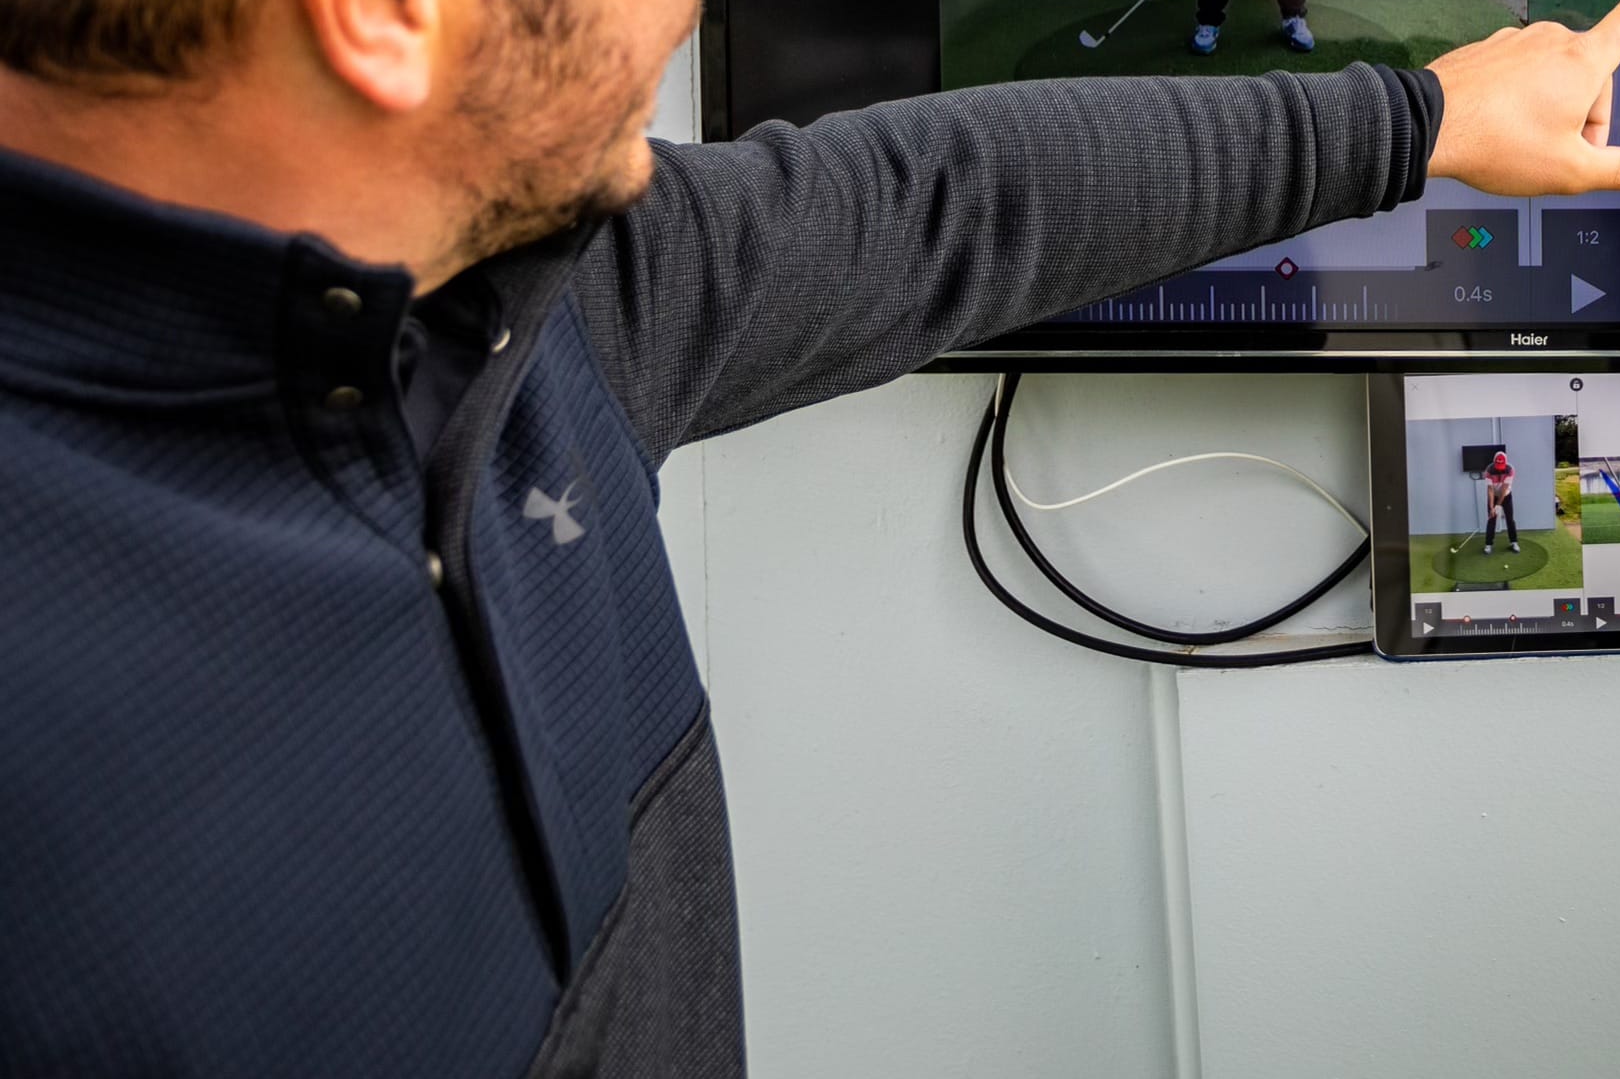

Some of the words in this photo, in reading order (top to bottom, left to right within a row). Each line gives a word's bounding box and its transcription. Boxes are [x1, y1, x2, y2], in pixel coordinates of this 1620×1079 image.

[1576, 230, 1600, 245] 1:2
[1453, 285, 1493, 302] 0.4s
[1510, 333, 1549, 346] Haier
